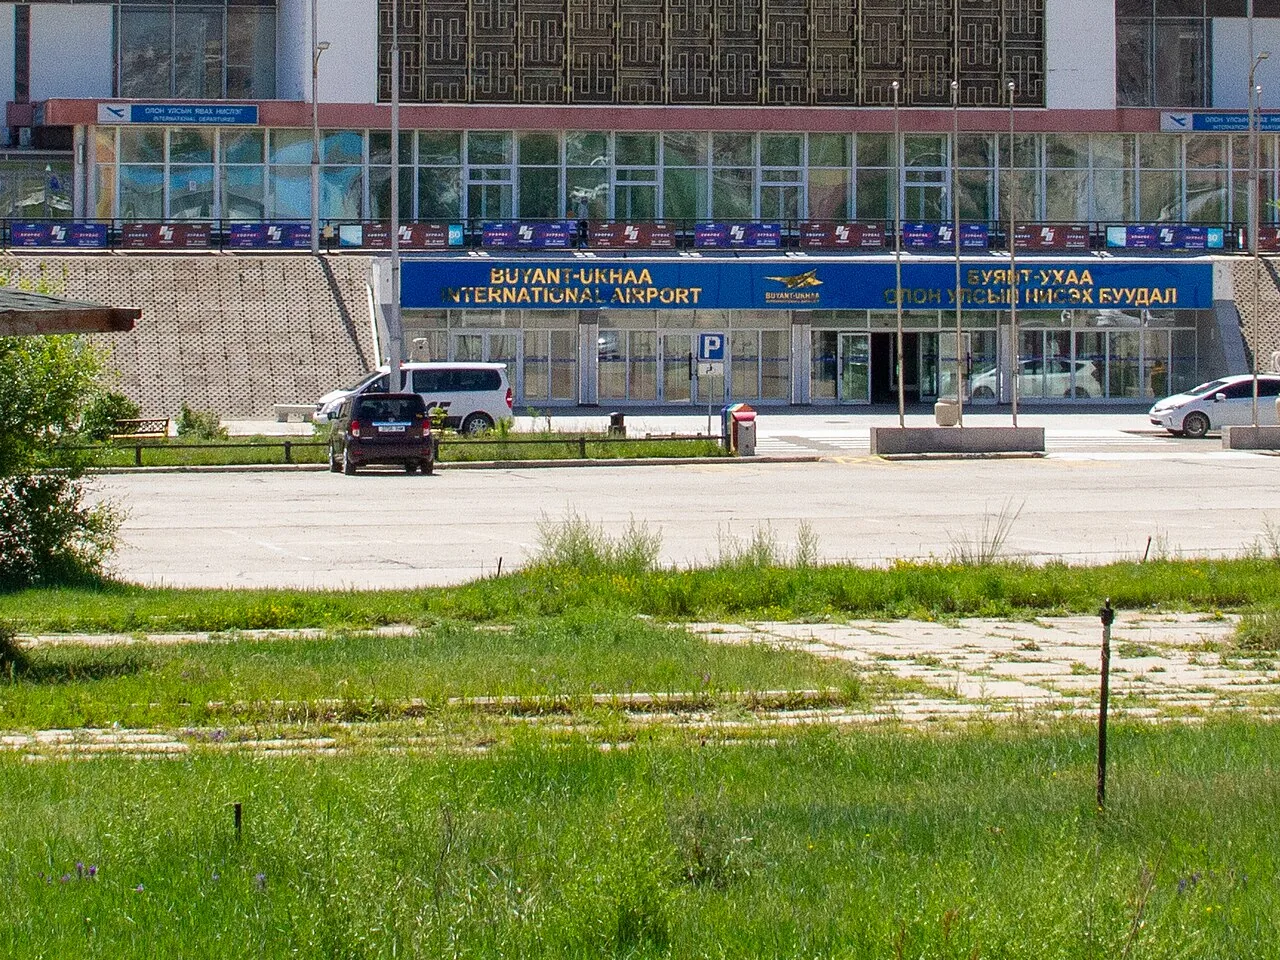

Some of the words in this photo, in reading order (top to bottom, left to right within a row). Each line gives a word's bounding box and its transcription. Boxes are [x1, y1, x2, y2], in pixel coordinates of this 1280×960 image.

[144, 107, 165, 115] ОЛОН
[167, 107, 193, 115] УЛСЫН
[194, 107, 214, 115] ЯВАХ
[215, 107, 243, 115] НИСЛЭГ
[490, 268, 652, 285] BUYANT-UKHAA
[966, 269, 1094, 286] БУЯНТ-УХАА
[441, 286, 602, 305] INTERNATIONAL
[611, 287, 702, 305] AIRPORT
[882, 288, 941, 305] ОЛОН
[1025, 288, 1094, 305] НИСЭХ
[1098, 288, 1178, 307] БУУДАЛ
[703, 335, 721, 358] P
